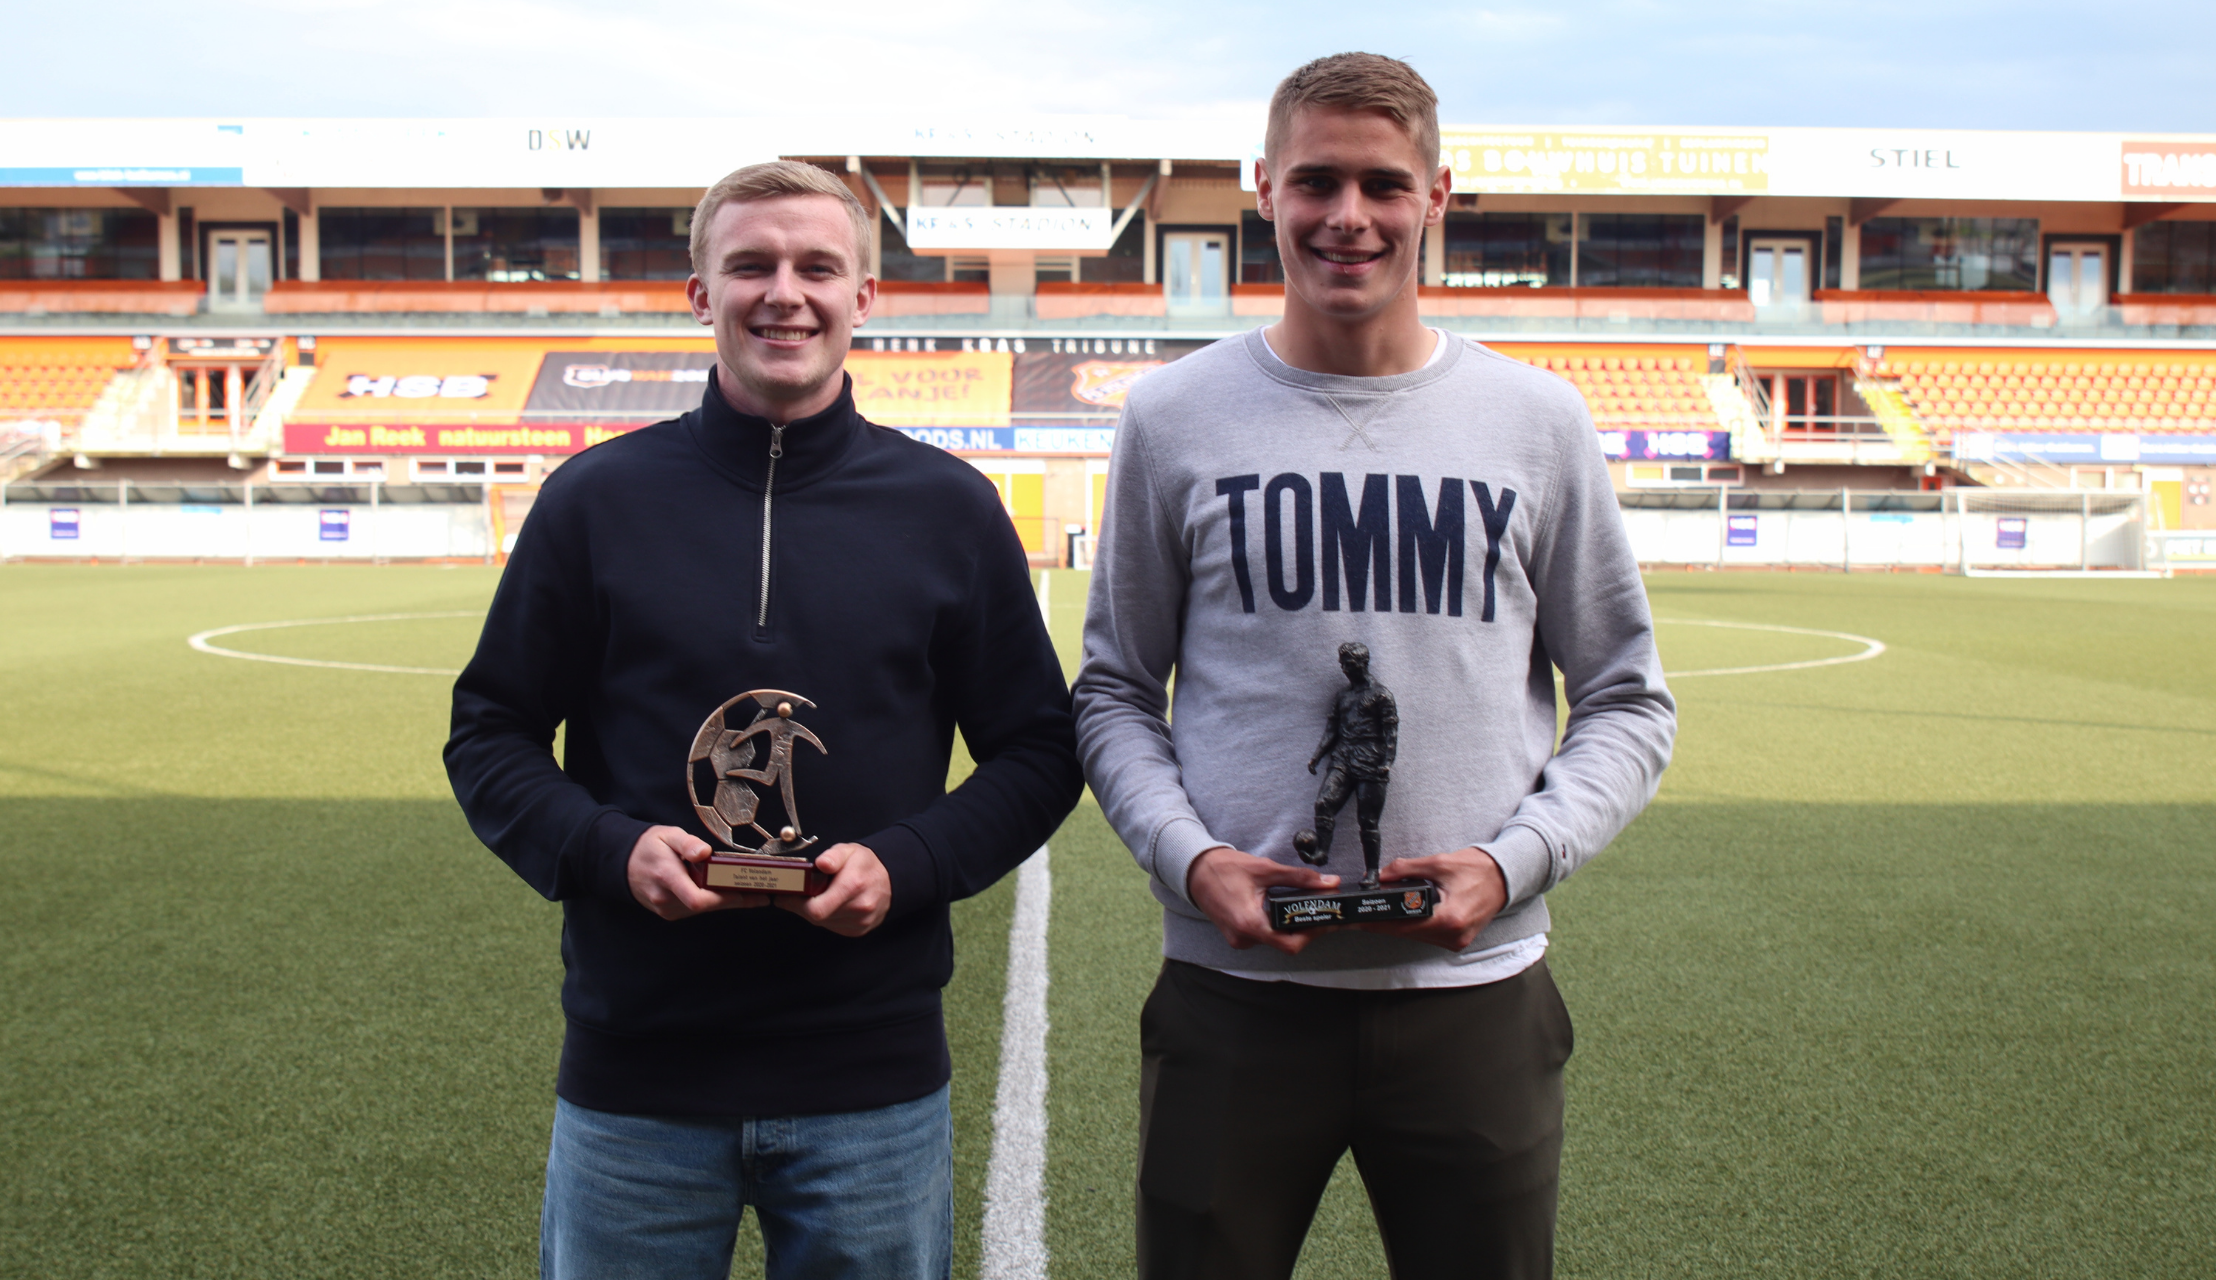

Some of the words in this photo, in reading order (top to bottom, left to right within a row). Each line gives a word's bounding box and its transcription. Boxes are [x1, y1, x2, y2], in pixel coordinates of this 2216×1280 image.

[1659, 151, 1769, 174] TUINEN
[1870, 148, 1960, 169] STIEL
[992, 217, 1092, 231] STADION
[872, 338, 937, 353] HENK
[962, 338, 1026, 354] KRAS
[1052, 339, 1156, 355] TRIBUNE
[891, 367, 985, 384] VOOR
[346, 375, 488, 399] HSB
[325, 426, 366, 446] Jan
[370, 426, 426, 446] Reek
[438, 427, 571, 447] natuursteen
[1215, 472, 1517, 623] TOMMY
[1284, 900, 1342, 915] VOLENDAM
[1361, 898, 1387, 906] Seizoen
[1377, 904, 1391, 912] 2021
[1294, 915, 1312, 923] Beste
